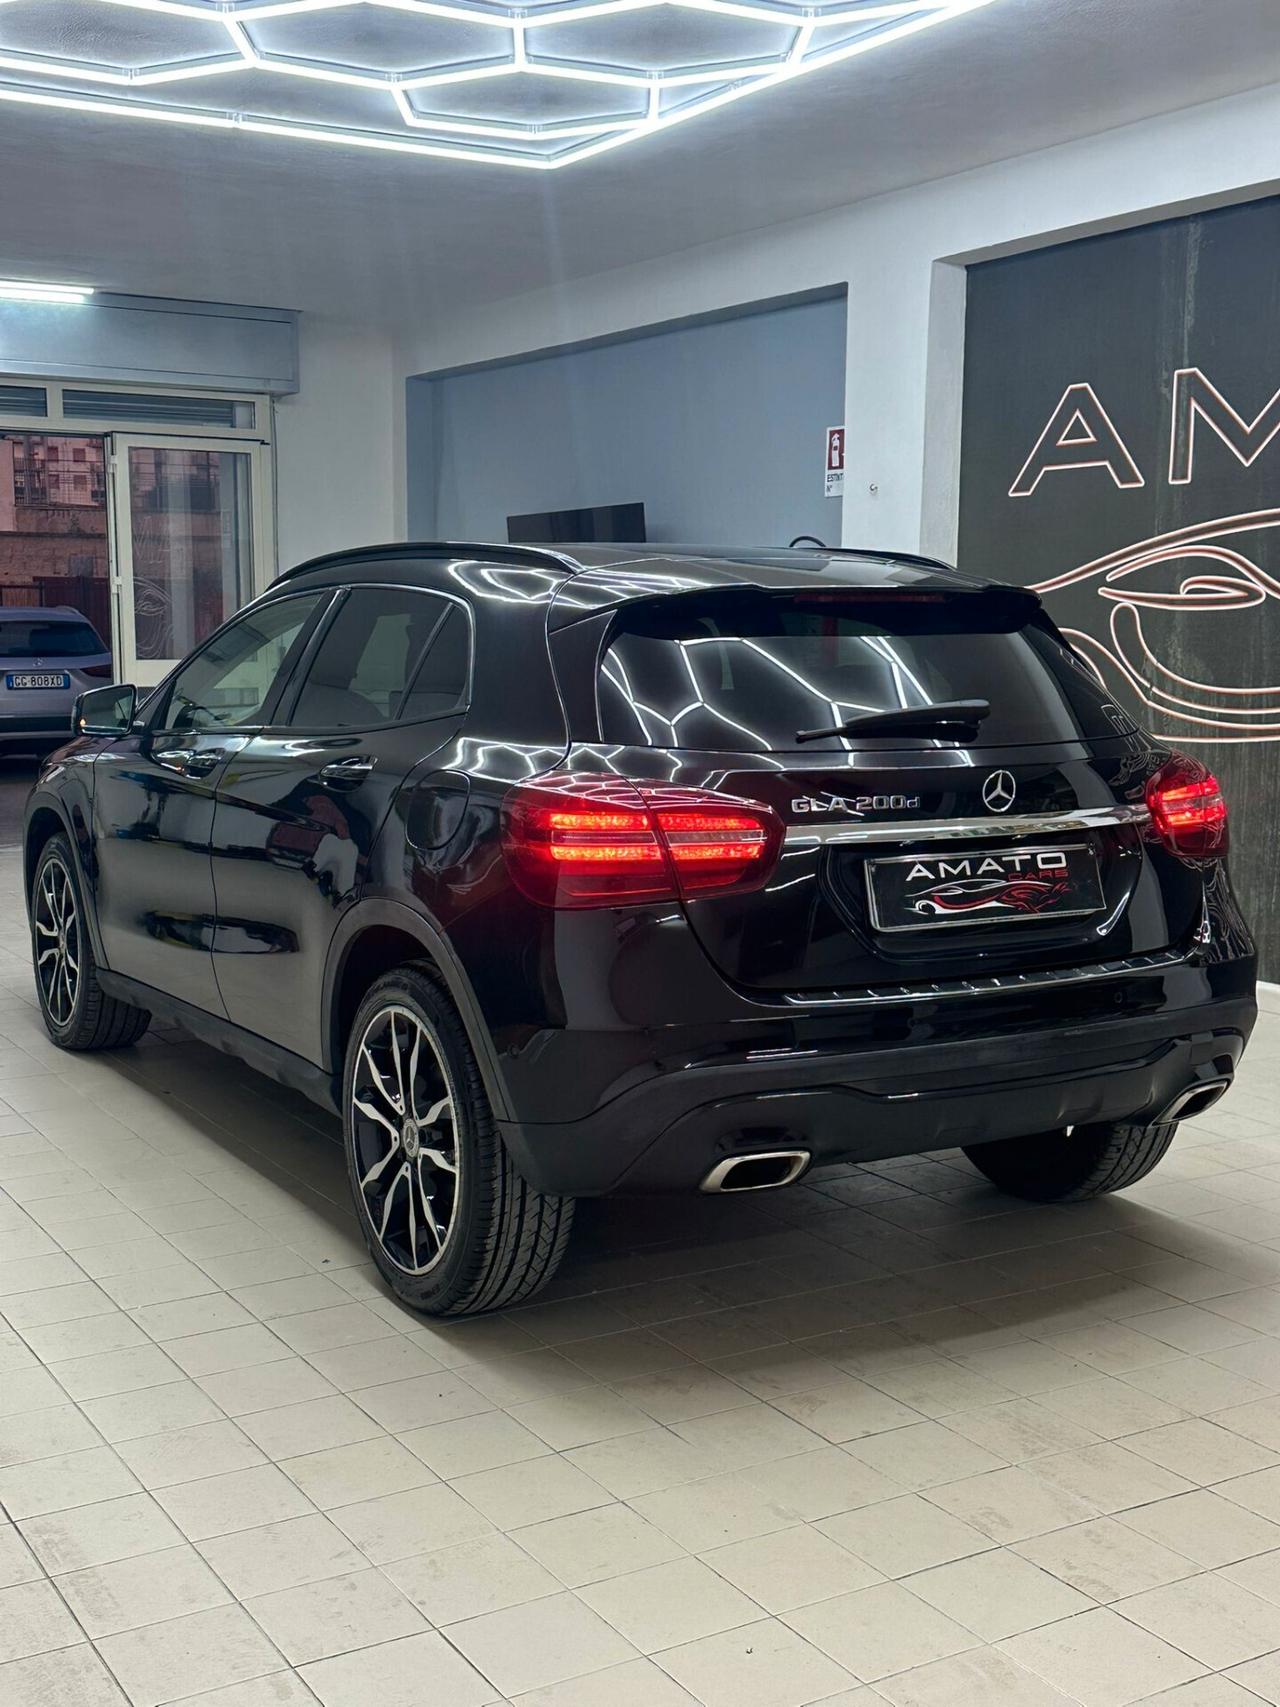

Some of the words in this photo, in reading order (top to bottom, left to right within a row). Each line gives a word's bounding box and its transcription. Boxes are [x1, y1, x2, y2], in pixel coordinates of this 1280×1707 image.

[791, 797, 848, 813] GLA
[855, 795, 920, 811] 200d
[905, 851, 1067, 882] AMATO
[1008, 868, 1070, 882] CARS
